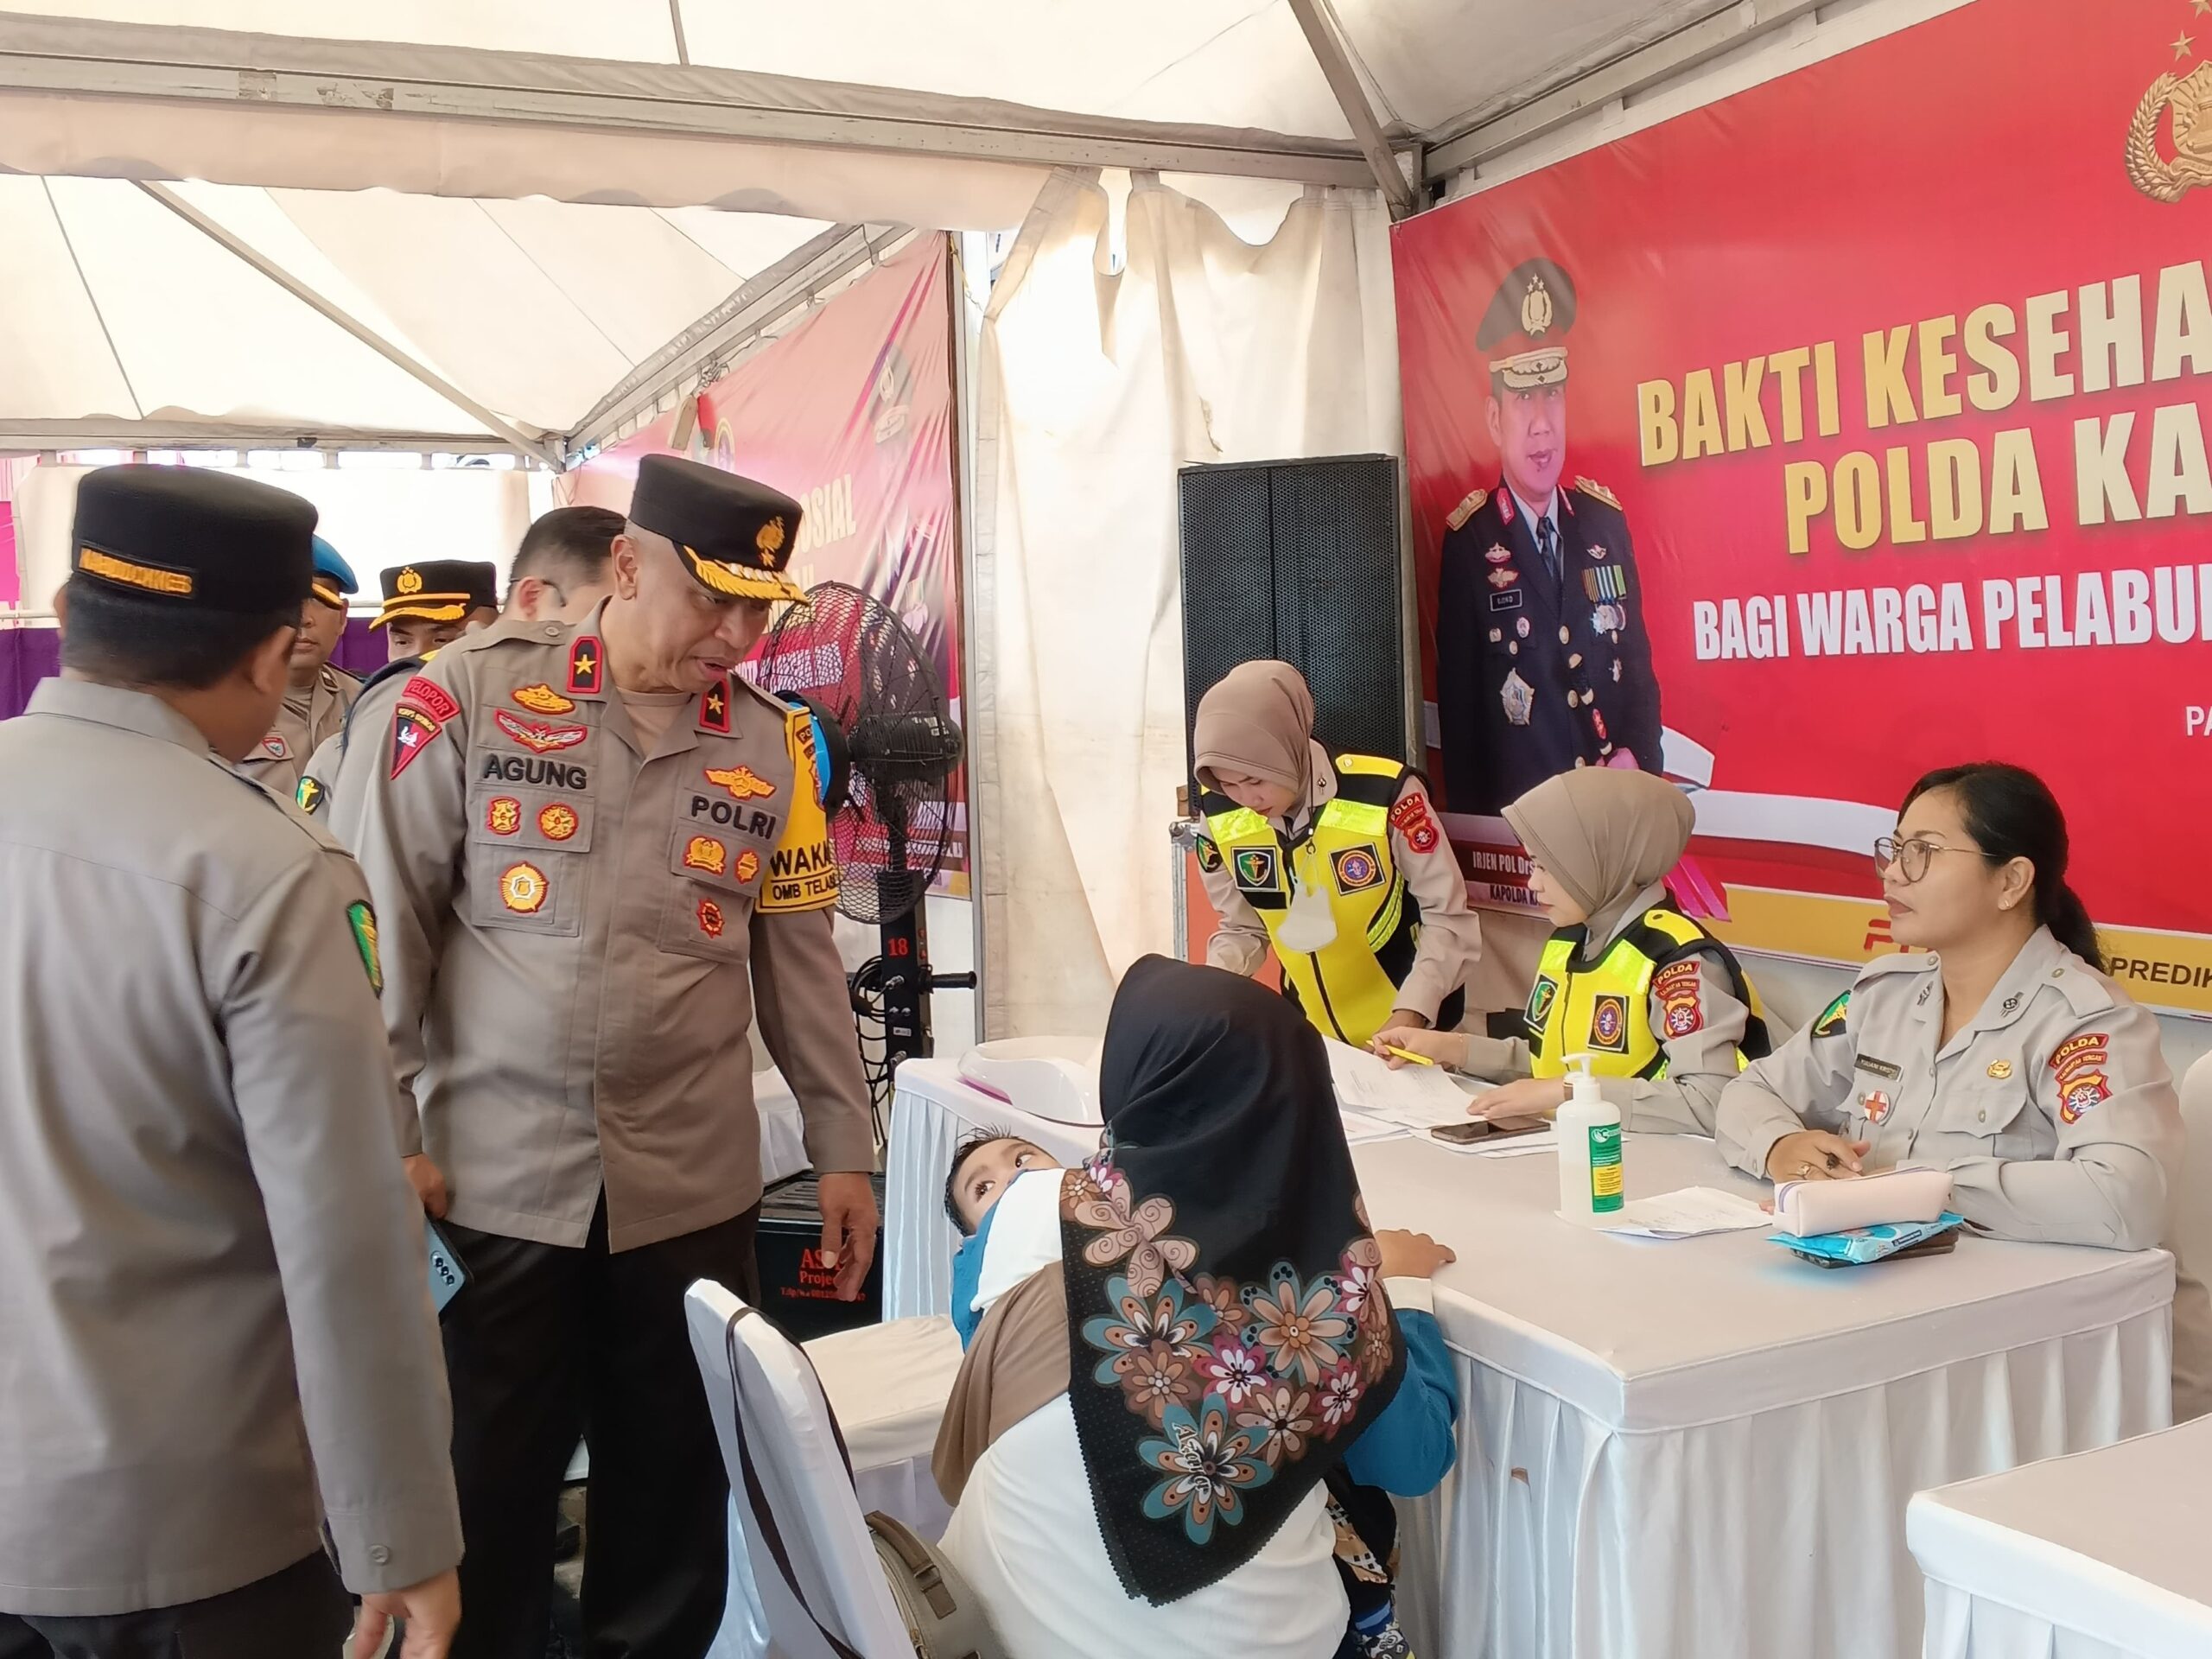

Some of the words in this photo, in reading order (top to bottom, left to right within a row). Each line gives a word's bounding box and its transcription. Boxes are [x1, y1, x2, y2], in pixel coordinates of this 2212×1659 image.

[1637, 340, 1840, 467] BAKTI
[1863, 260, 2212, 429] KESEHA
[1784, 428, 2050, 554] POLDA
[2074, 402, 2212, 525] KA
[791, 474, 857, 557] OSIAL
[1694, 594, 1789, 660] BAGI
[1796, 582, 1974, 657] WARGA
[407, 681, 449, 715] PELOPOR
[484, 753, 588, 790] AGUNG
[691, 795, 776, 840] POLRI
[1390, 795, 1421, 822] POLDA
[1472, 850, 1497, 871] IRJEN
[1498, 854, 1516, 874] POL
[772, 883, 801, 900] OMB
[1490, 884, 1528, 906] KAPOLDA
[887, 938, 909, 957] 18
[1657, 963, 1693, 985] POLDA
[2055, 1037, 2099, 1065] POLDA
